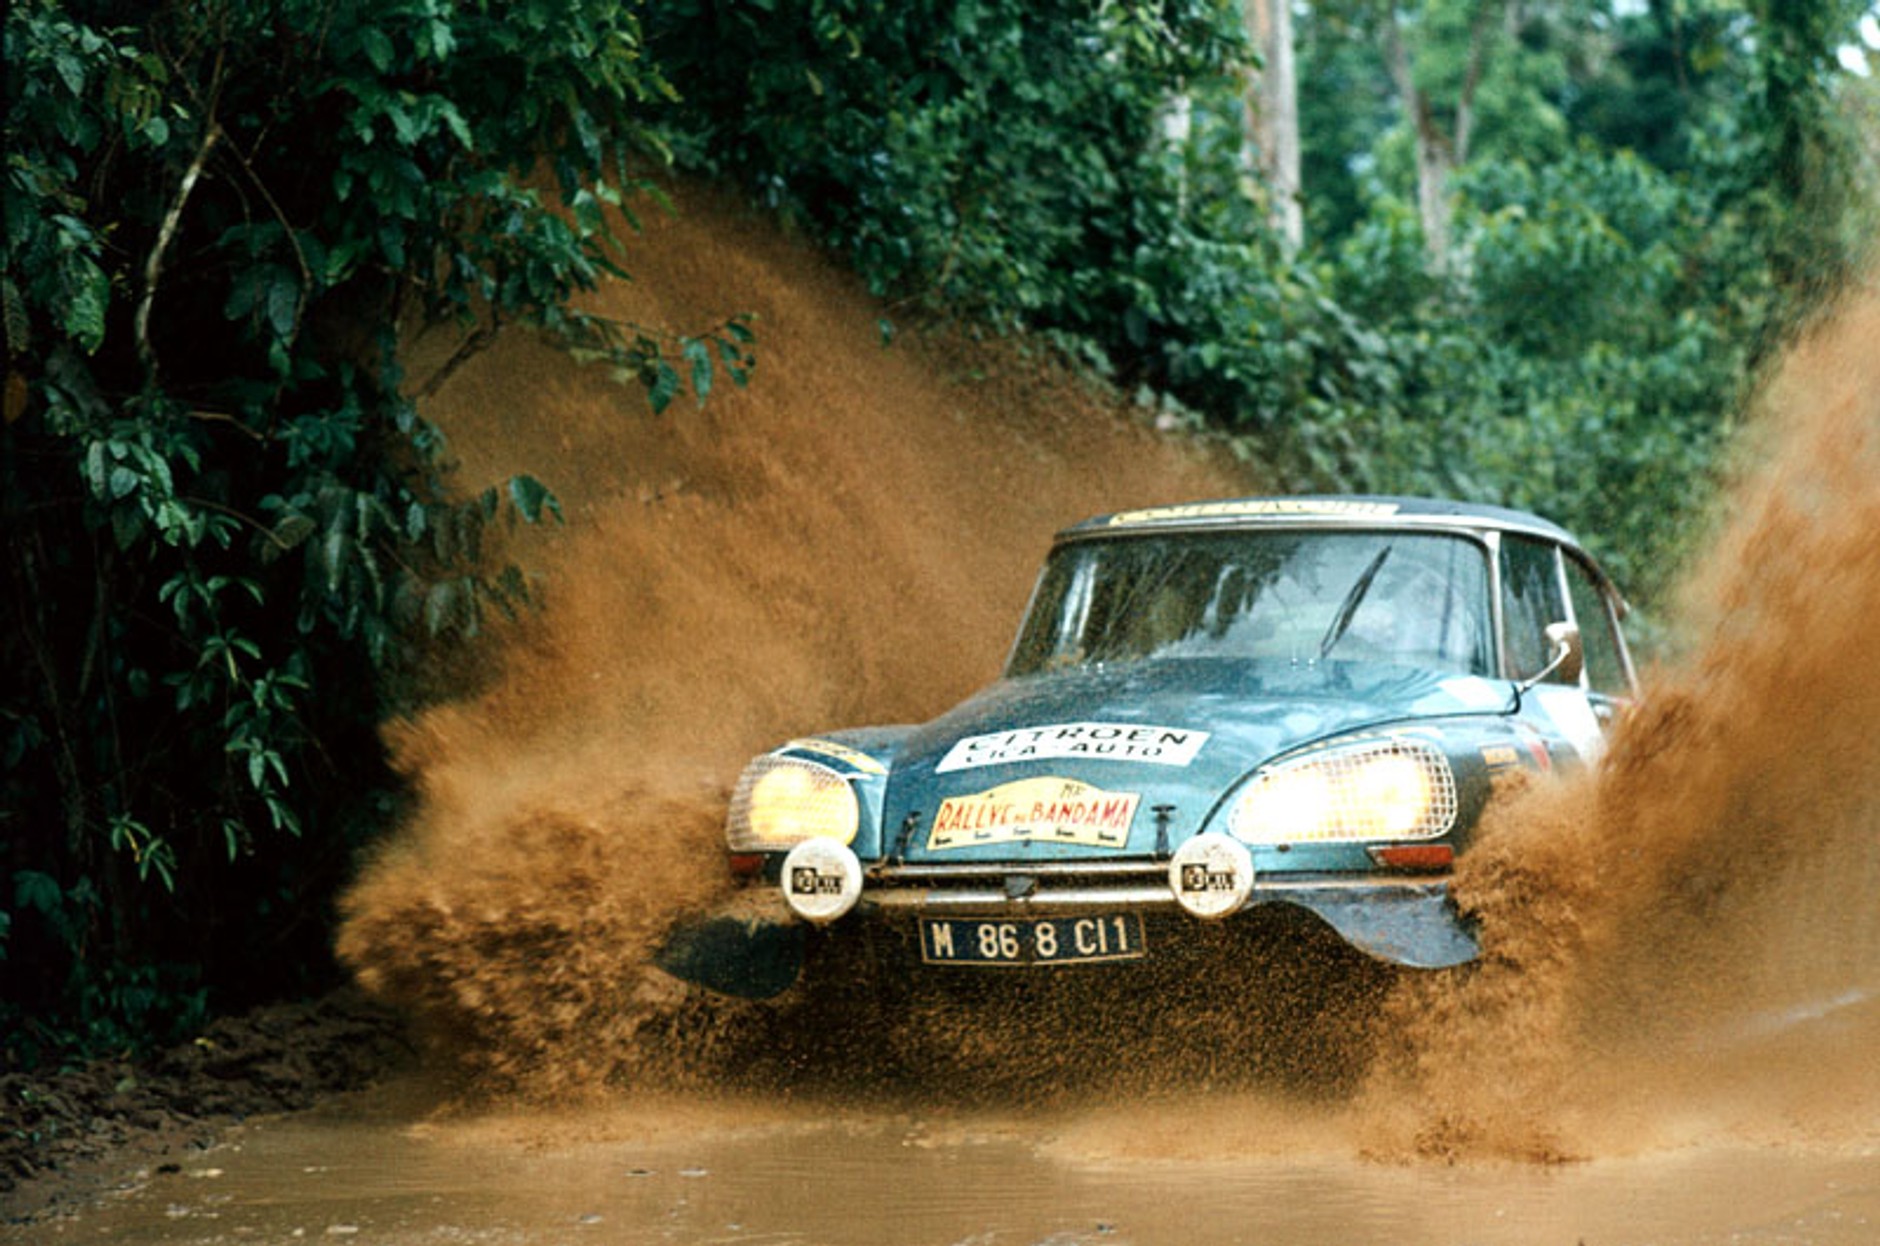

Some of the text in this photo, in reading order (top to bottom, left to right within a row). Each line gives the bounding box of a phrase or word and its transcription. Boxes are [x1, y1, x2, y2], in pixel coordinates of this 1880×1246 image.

[967, 727, 1188, 751] CITROEN
[1069, 742, 1163, 757] AUTO
[935, 801, 1015, 833] RALLYE
[1029, 798, 1129, 829] BANDAMA
[931, 921, 955, 958] M
